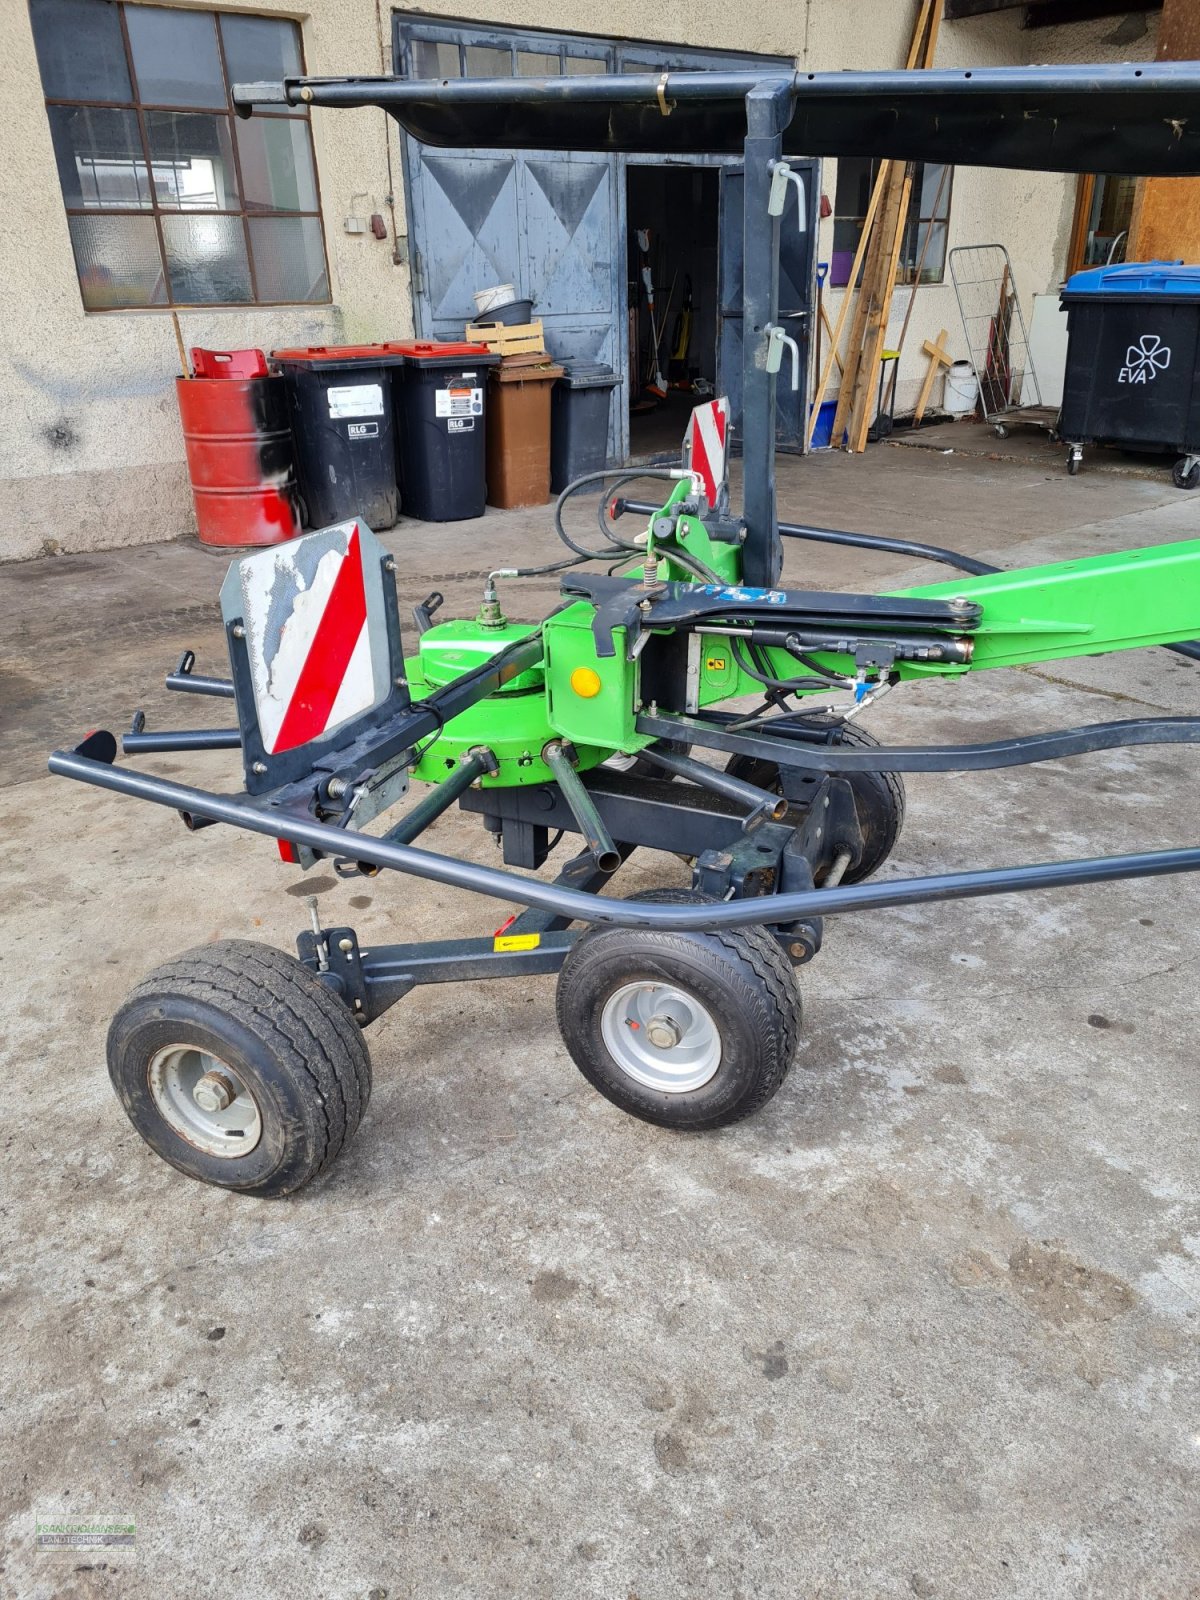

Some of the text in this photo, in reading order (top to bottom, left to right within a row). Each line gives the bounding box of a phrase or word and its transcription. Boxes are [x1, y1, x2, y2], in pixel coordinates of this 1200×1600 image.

[1118, 367, 1146, 384] EVA
[449, 419, 464, 428] RLG
[350, 425, 367, 434] RLG
